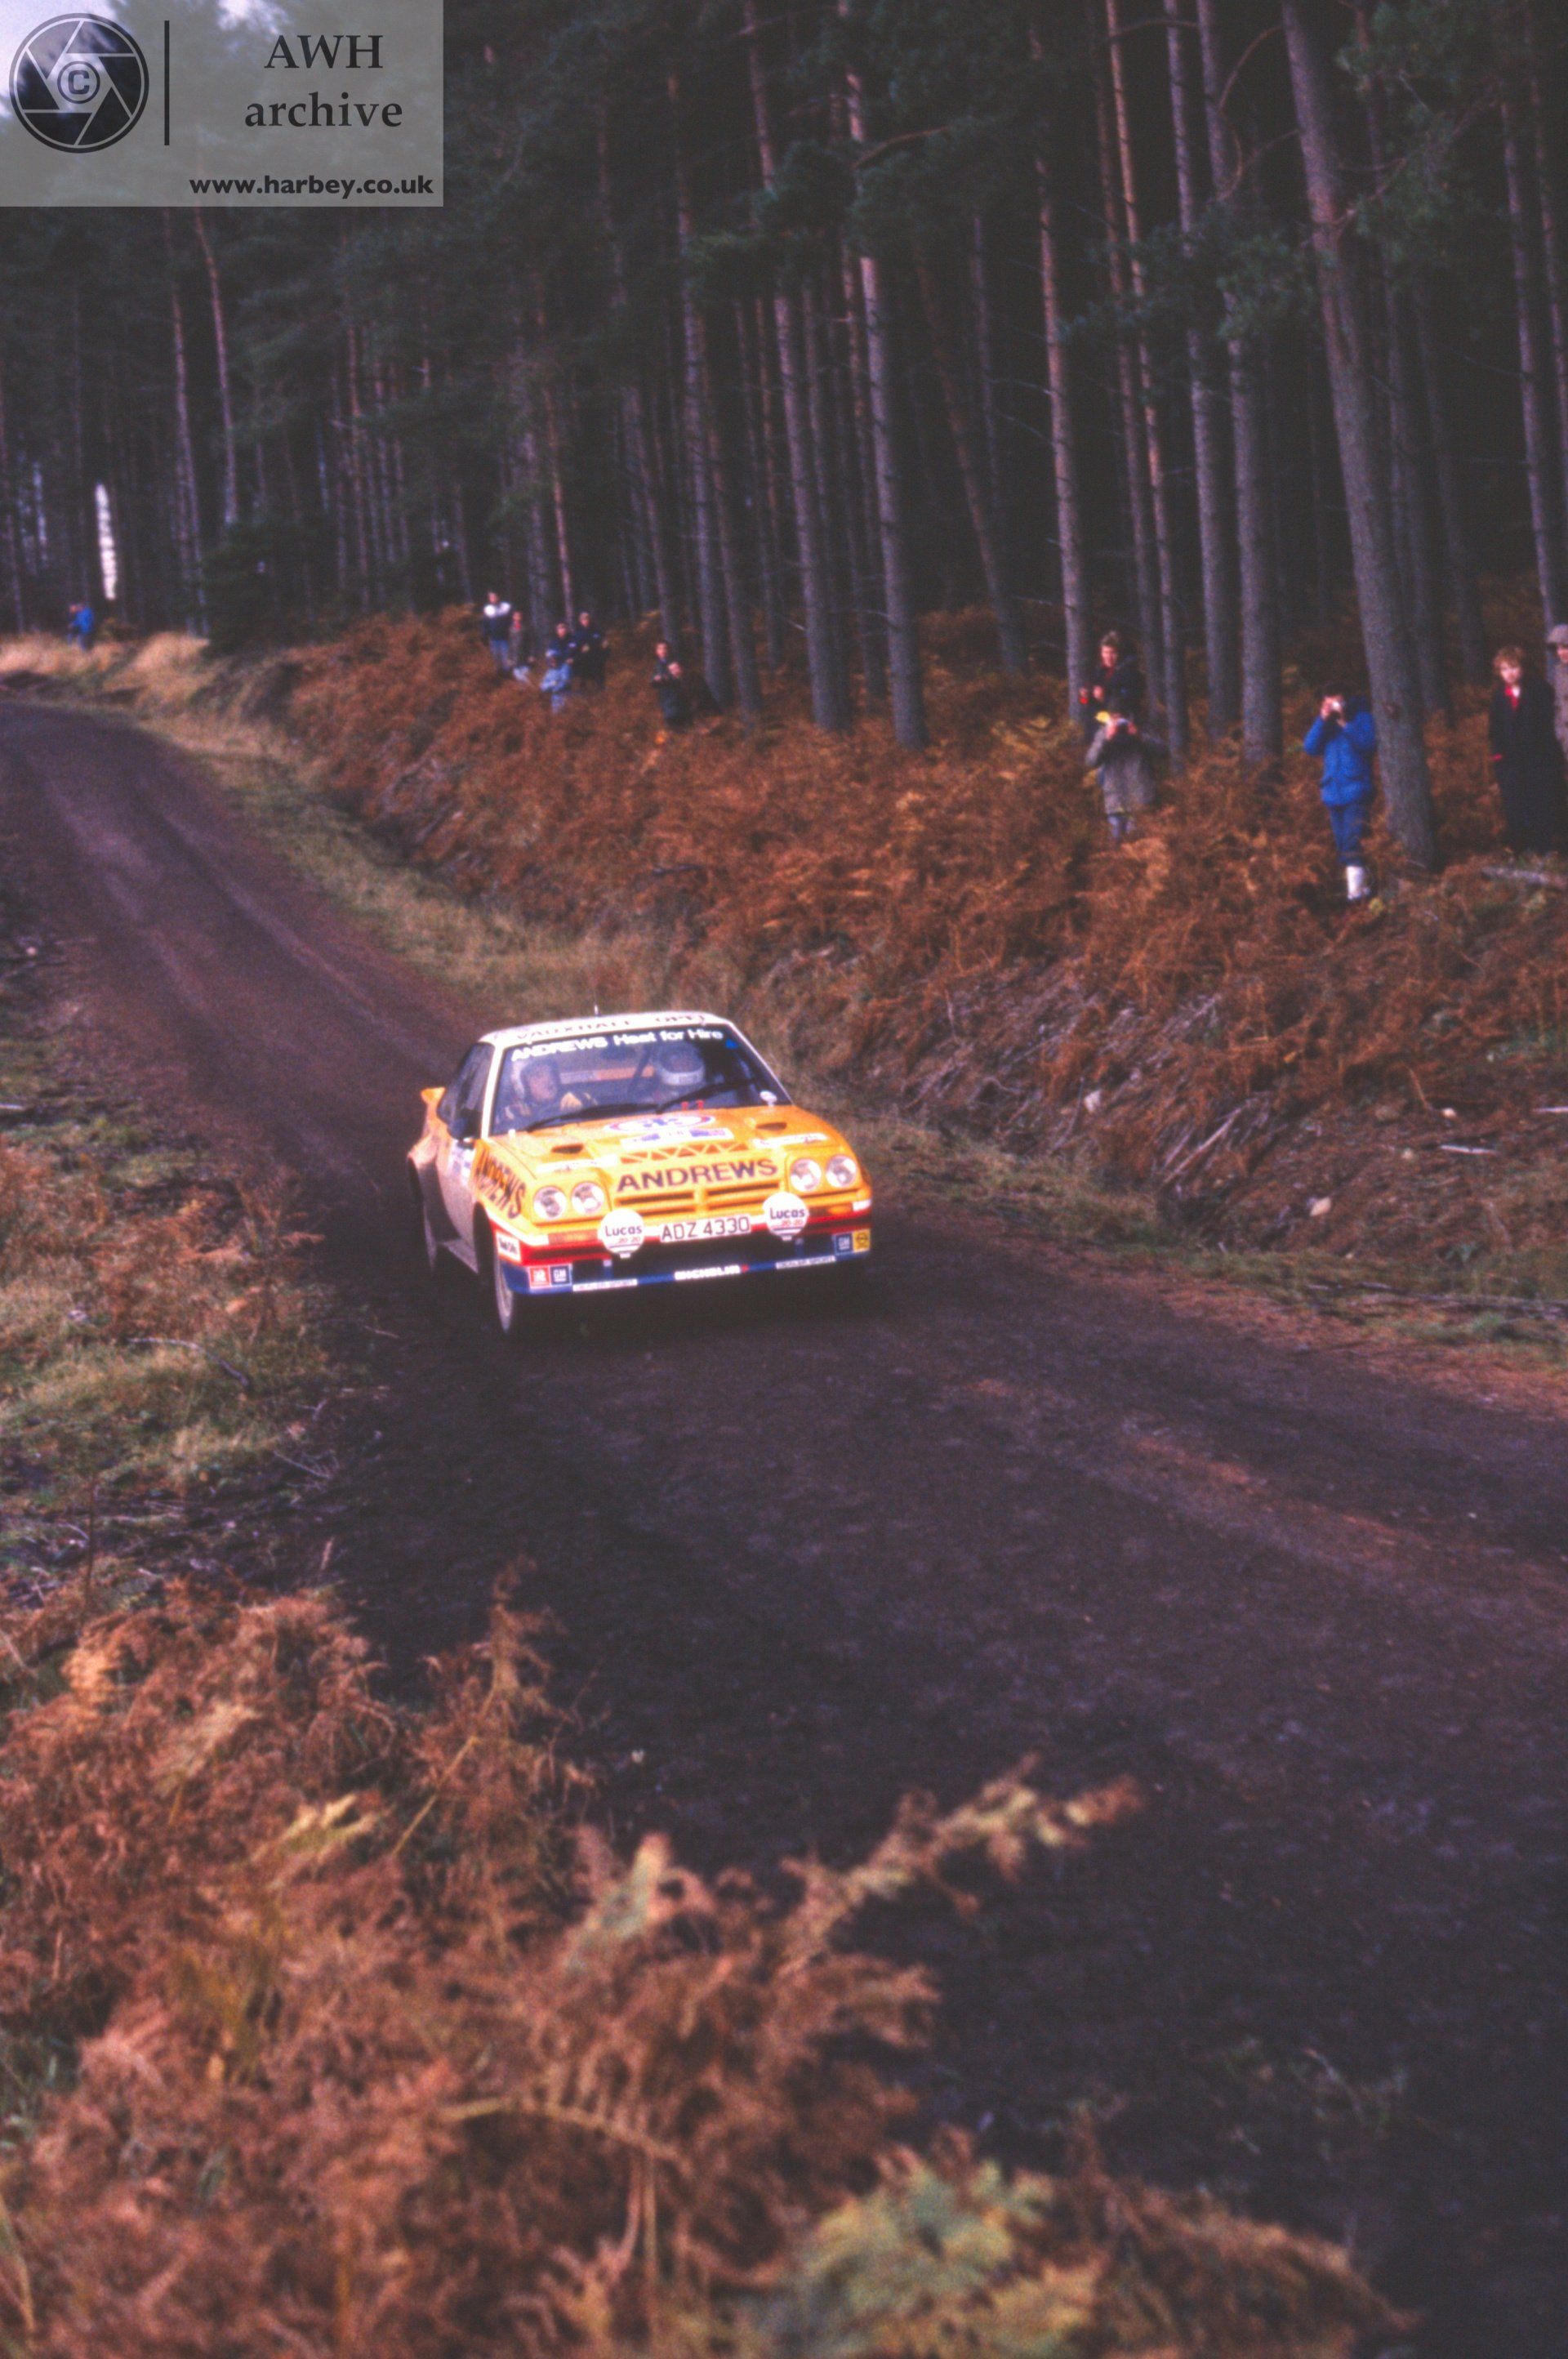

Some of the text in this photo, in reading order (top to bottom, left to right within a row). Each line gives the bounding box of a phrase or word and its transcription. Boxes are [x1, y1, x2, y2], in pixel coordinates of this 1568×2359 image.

[511, 1036, 608, 1062] ANDREWS
[660, 1030, 684, 1041] for
[687, 1028, 724, 1040] Hire
[617, 1158, 778, 1193] ANDREWS
[769, 1207, 805, 1220] Lucas
[604, 1224, 643, 1237] Lucas
[662, 1215, 751, 1241] ADZ 4330
